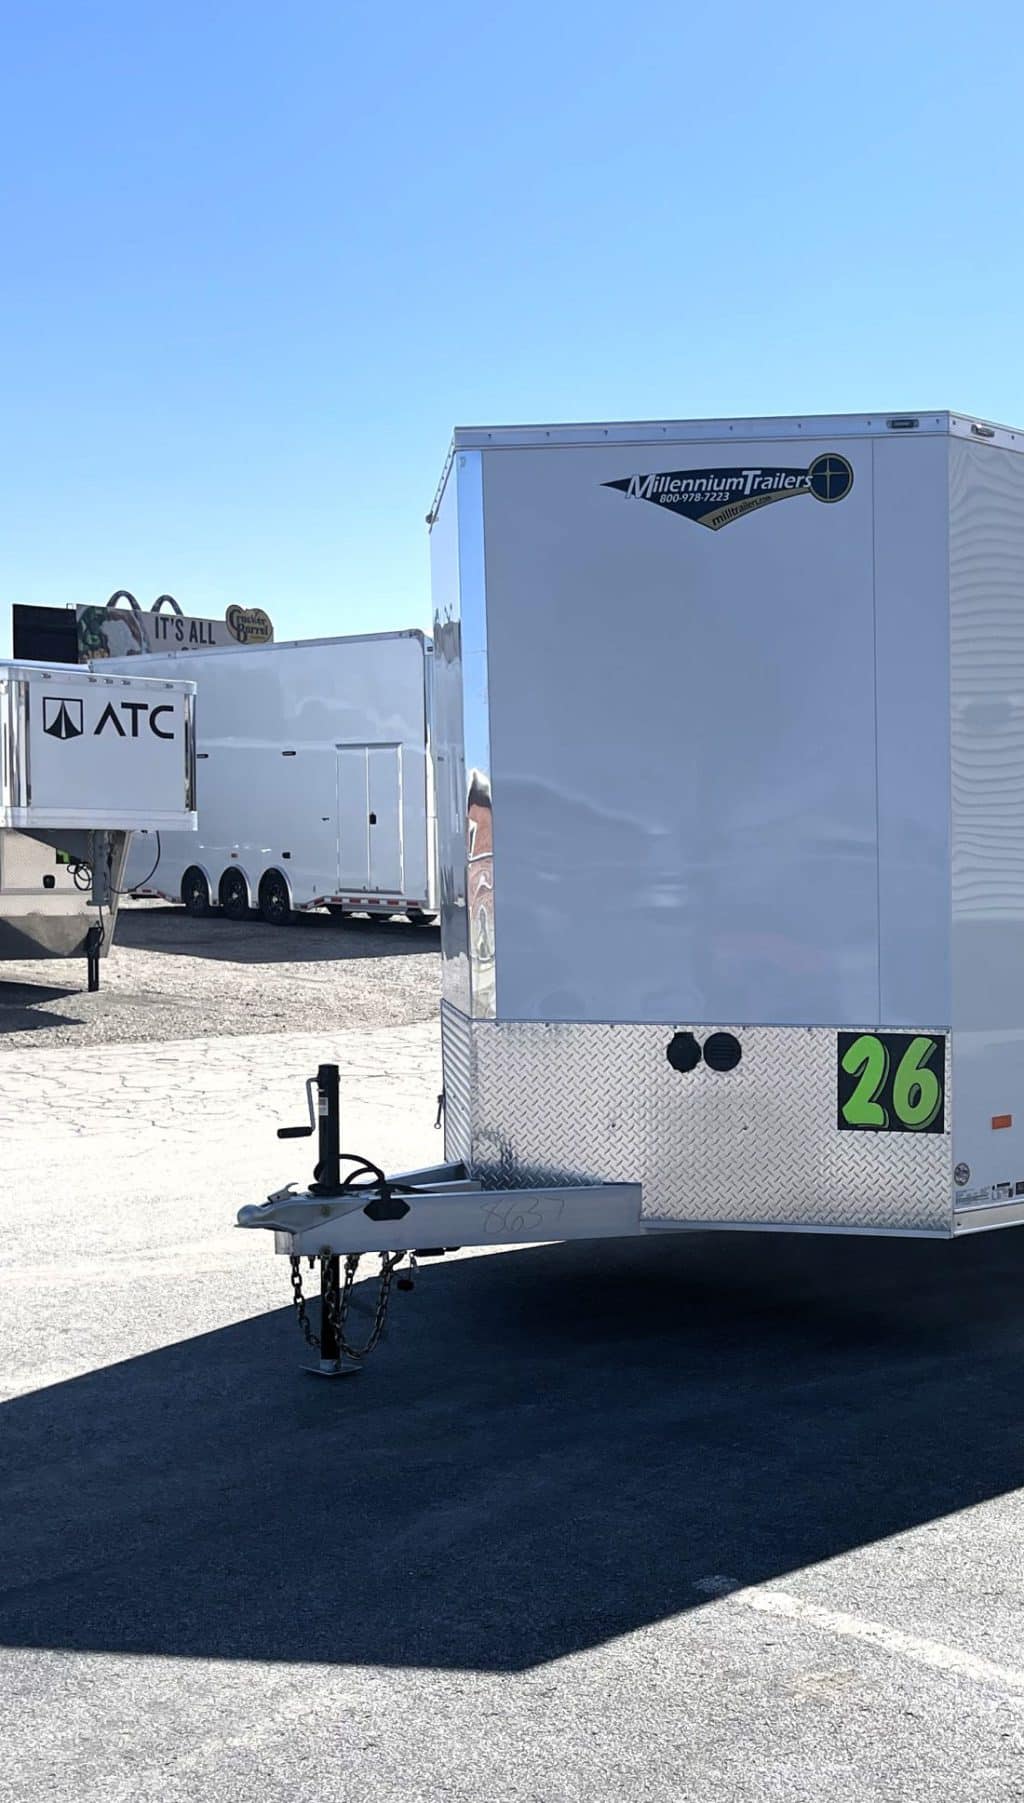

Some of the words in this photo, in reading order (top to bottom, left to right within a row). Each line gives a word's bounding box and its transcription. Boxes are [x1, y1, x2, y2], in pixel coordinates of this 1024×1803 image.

[659, 491, 730, 504] 800-978-7223
[155, 616, 184, 642] IT'S
[189, 621, 217, 645] ALL
[93, 701, 175, 740] ATC
[841, 1034, 942, 1131] 26
